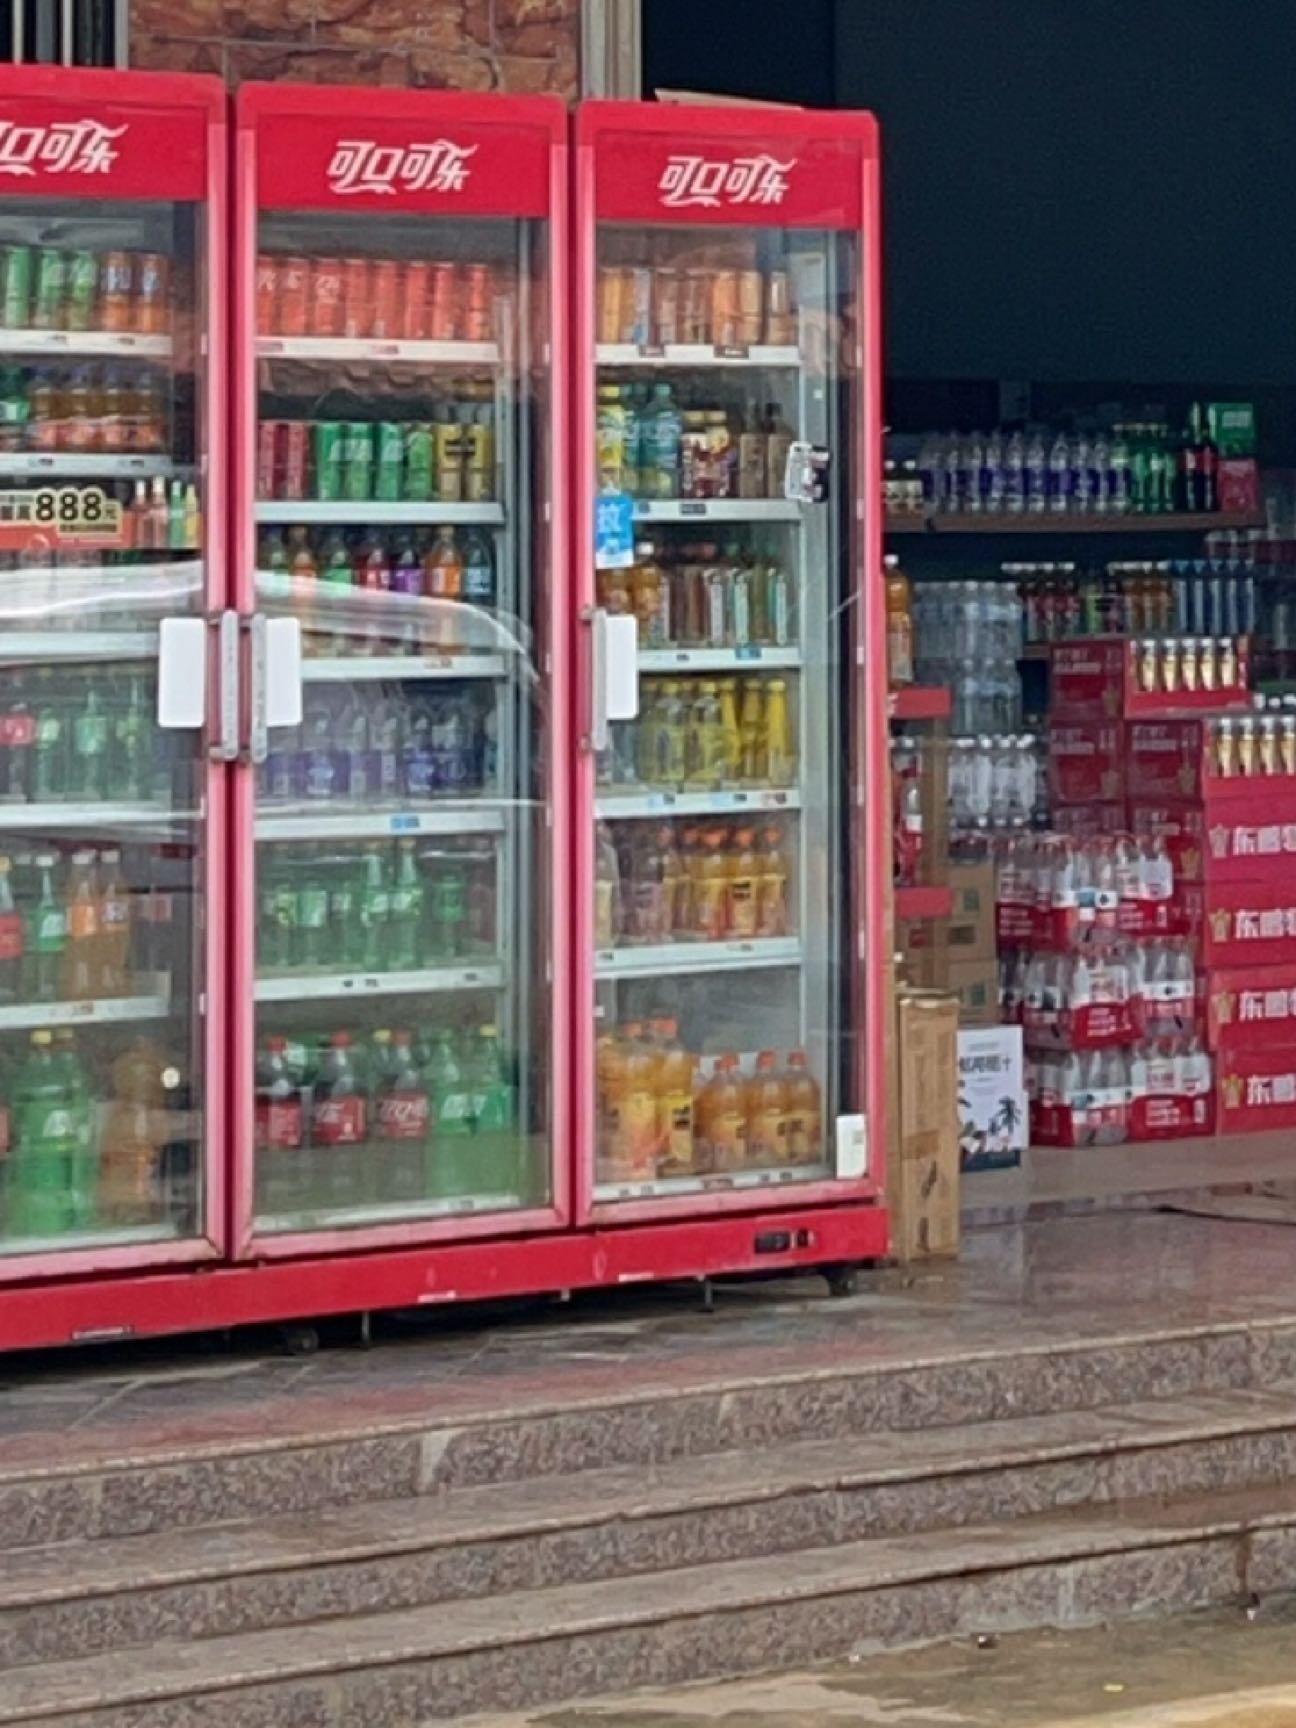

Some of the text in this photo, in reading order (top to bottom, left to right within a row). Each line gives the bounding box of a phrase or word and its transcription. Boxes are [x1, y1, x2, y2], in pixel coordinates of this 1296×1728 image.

[0, 117, 129, 176] 口可乐
[327, 137, 479, 195] 可口可乐
[659, 152, 798, 209] 可口可乐
